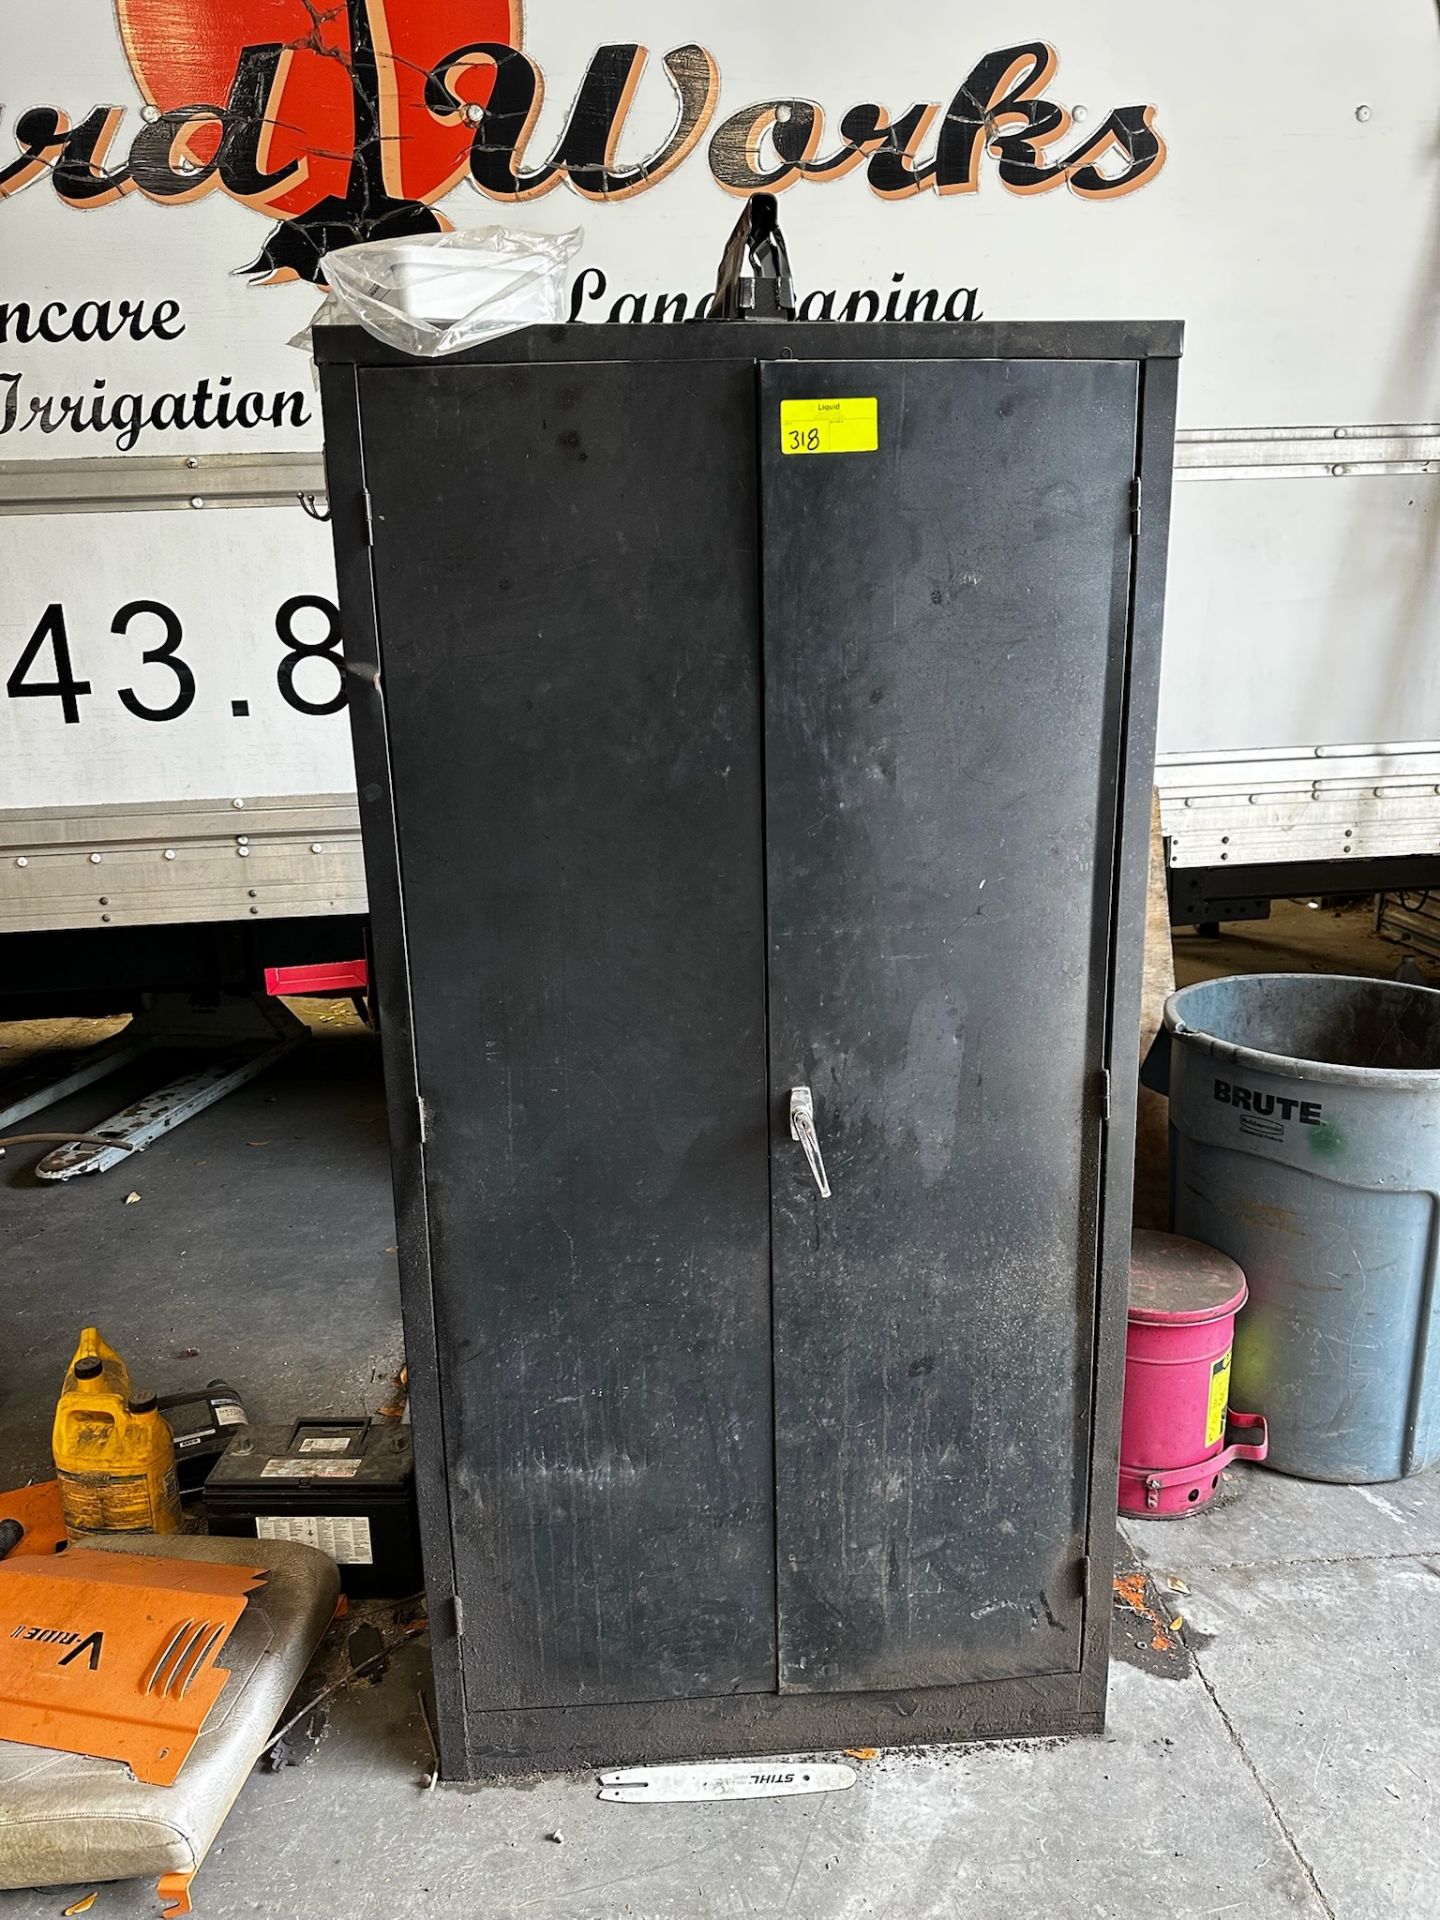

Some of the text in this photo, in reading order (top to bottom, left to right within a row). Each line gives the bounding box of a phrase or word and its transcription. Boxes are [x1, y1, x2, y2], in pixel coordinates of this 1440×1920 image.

[423, 39, 1168, 203] Works
[567, 268, 984, 322] Lanaping
[788, 427, 820, 451] 318
[1214, 1078, 1322, 1126] BRUTE
[23, 1627, 104, 1671] V-RIDE
[750, 1773, 795, 1784] STIHL
